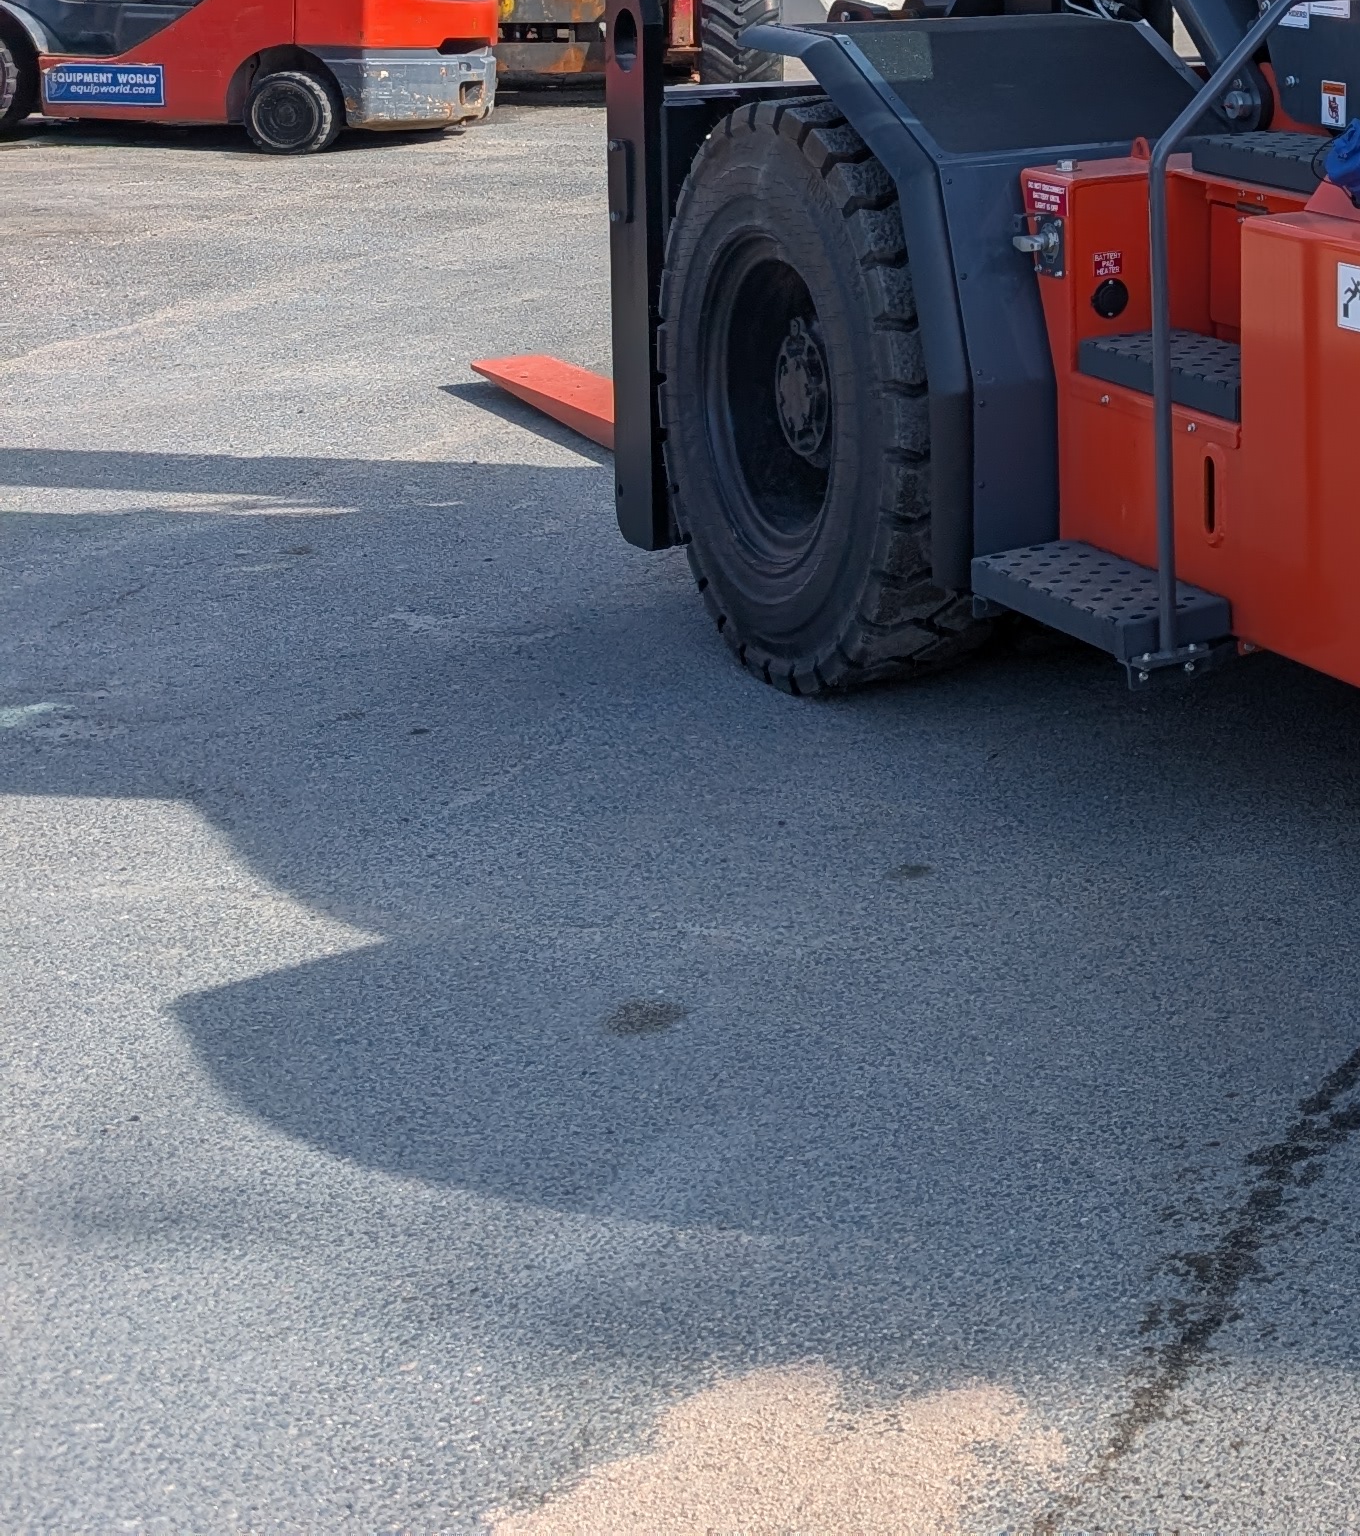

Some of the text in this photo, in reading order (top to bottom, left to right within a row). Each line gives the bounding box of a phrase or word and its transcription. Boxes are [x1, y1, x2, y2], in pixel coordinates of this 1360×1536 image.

[51, 72, 157, 84] EQUIPMENT WORLD
[70, 84, 156, 95] equipworld.com
[1094, 252, 1122, 262] BATTERY
